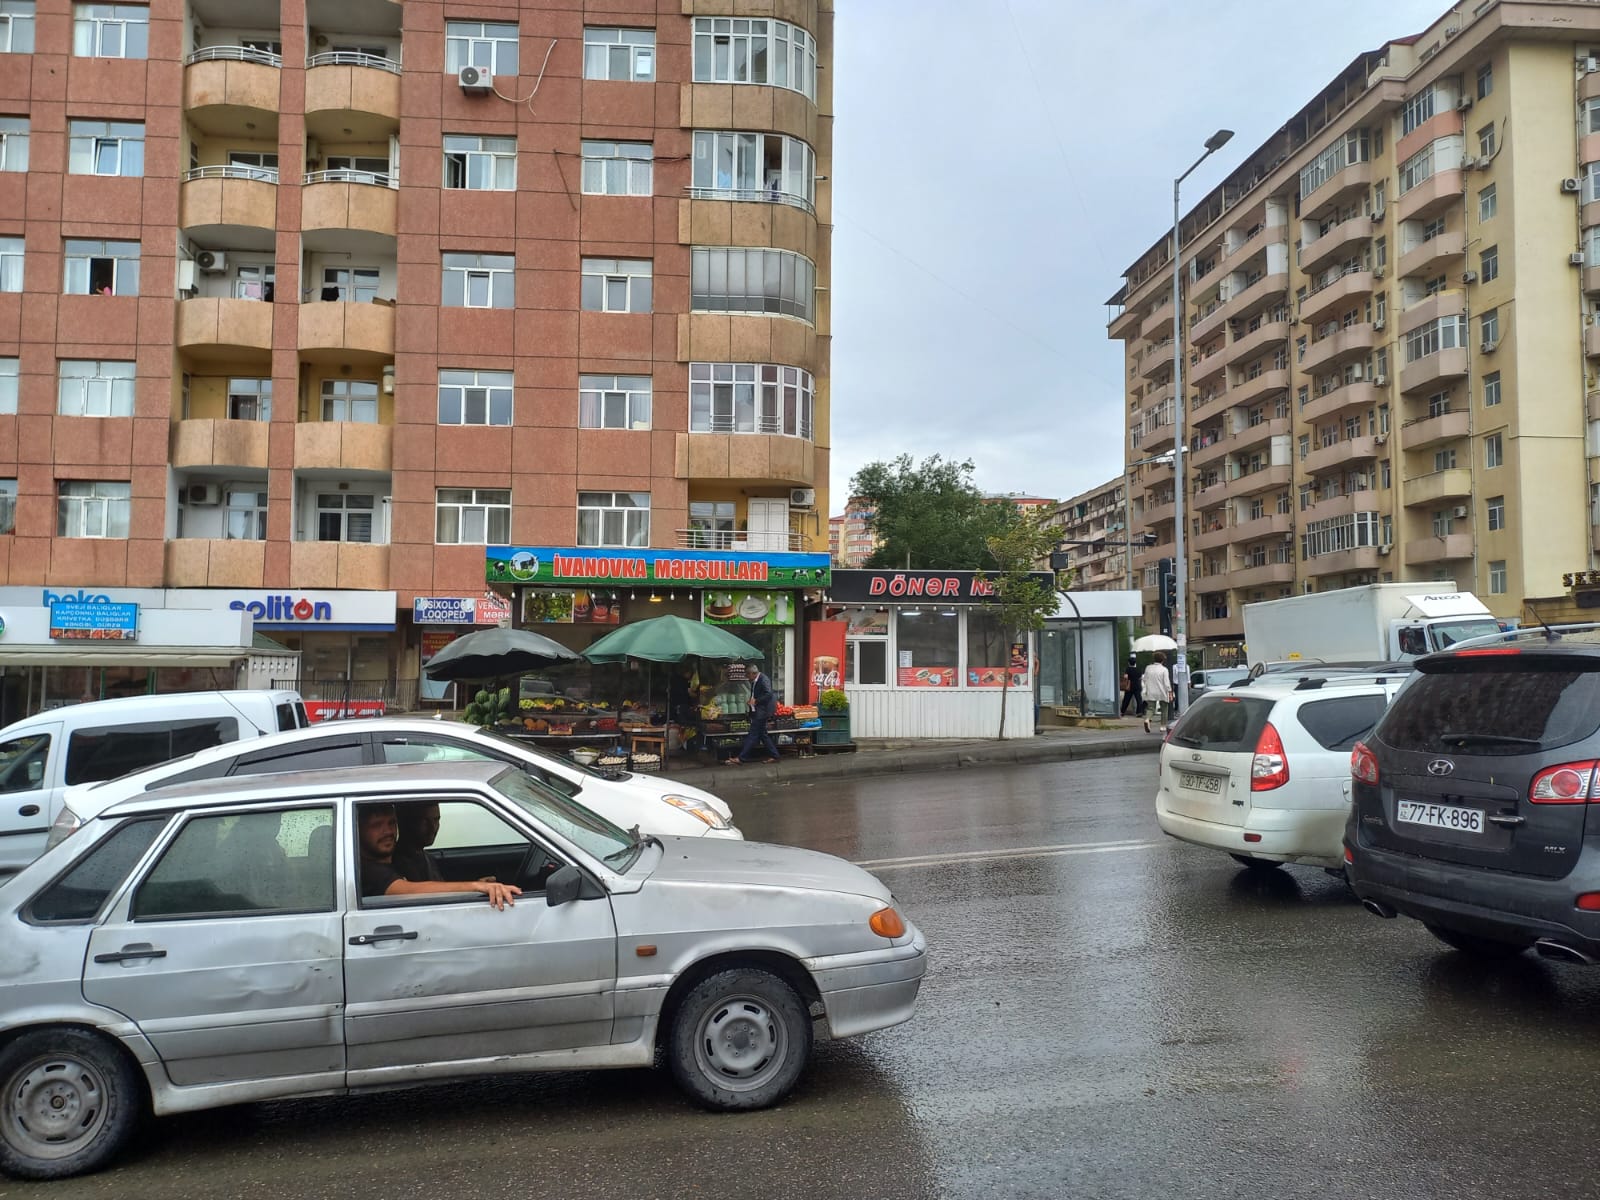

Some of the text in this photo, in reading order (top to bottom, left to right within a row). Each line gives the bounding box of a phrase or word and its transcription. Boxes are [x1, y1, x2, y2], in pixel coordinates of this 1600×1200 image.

[553, 553, 769, 582] İVANOVKA MƏHSULLARI
[869, 574, 960, 597] DÖNƏR
[1410, 803, 1480, 830] 77-FK-896
